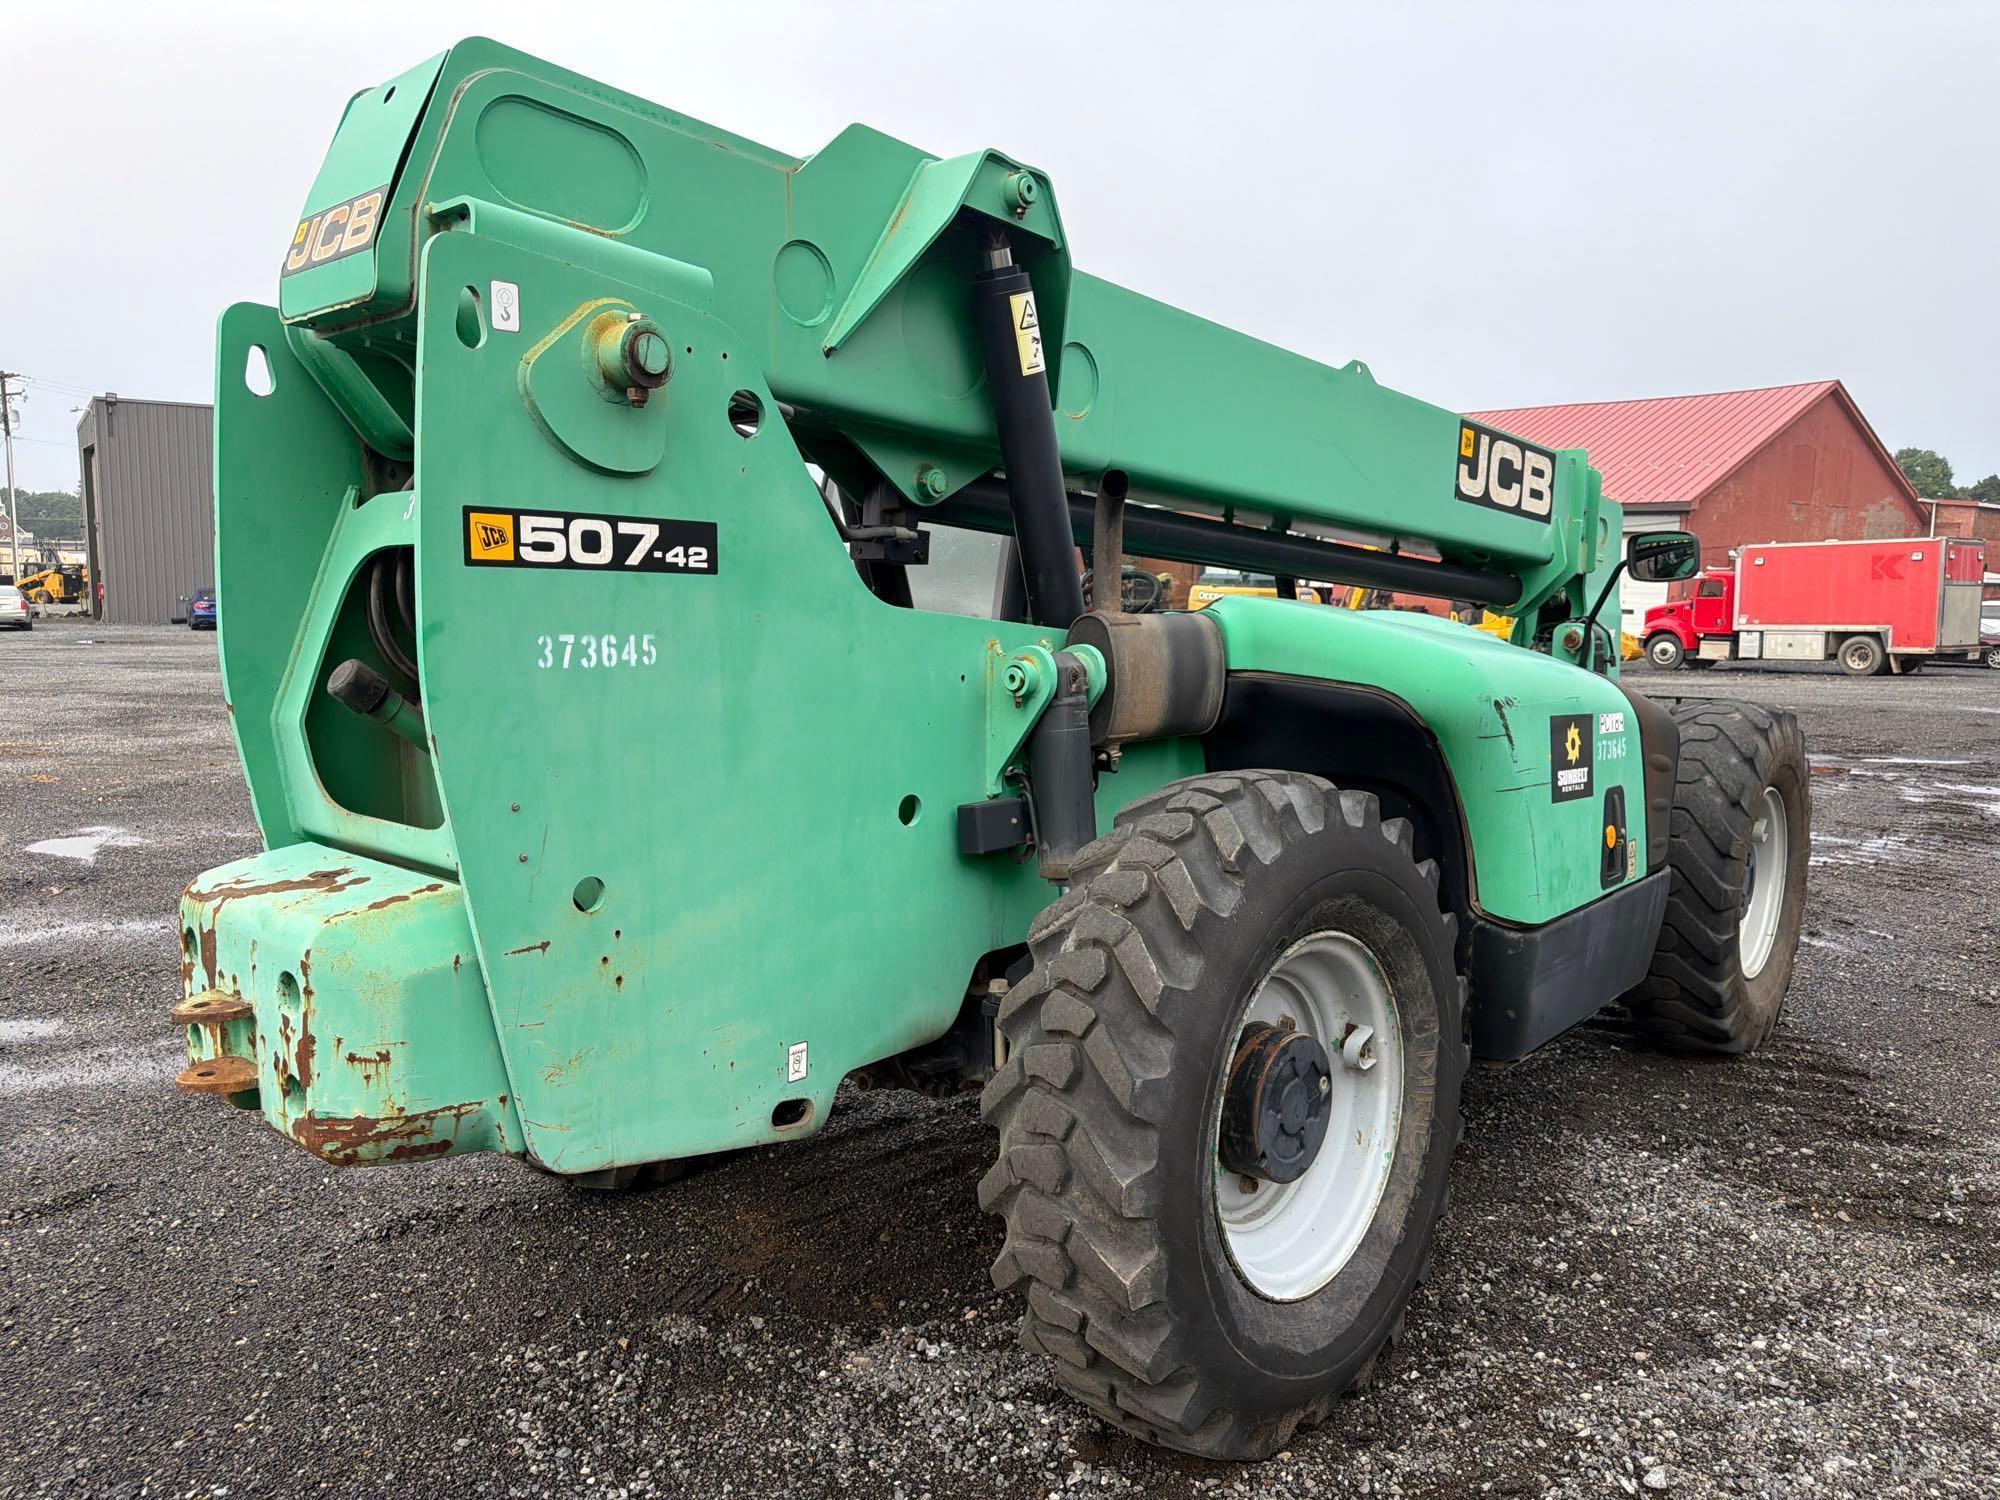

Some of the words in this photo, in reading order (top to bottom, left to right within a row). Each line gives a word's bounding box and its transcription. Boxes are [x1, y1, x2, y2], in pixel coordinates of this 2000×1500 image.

[287, 193, 381, 270] JCB
[1459, 434, 1552, 515] JCB
[481, 525, 507, 547] JCB
[519, 515, 708, 568] 507-42
[537, 634, 657, 669] 373645
[1598, 737, 1626, 761] 373645
[1557, 767, 1588, 787] SUNBELT
[1562, 783, 1585, 793] RENTALS
